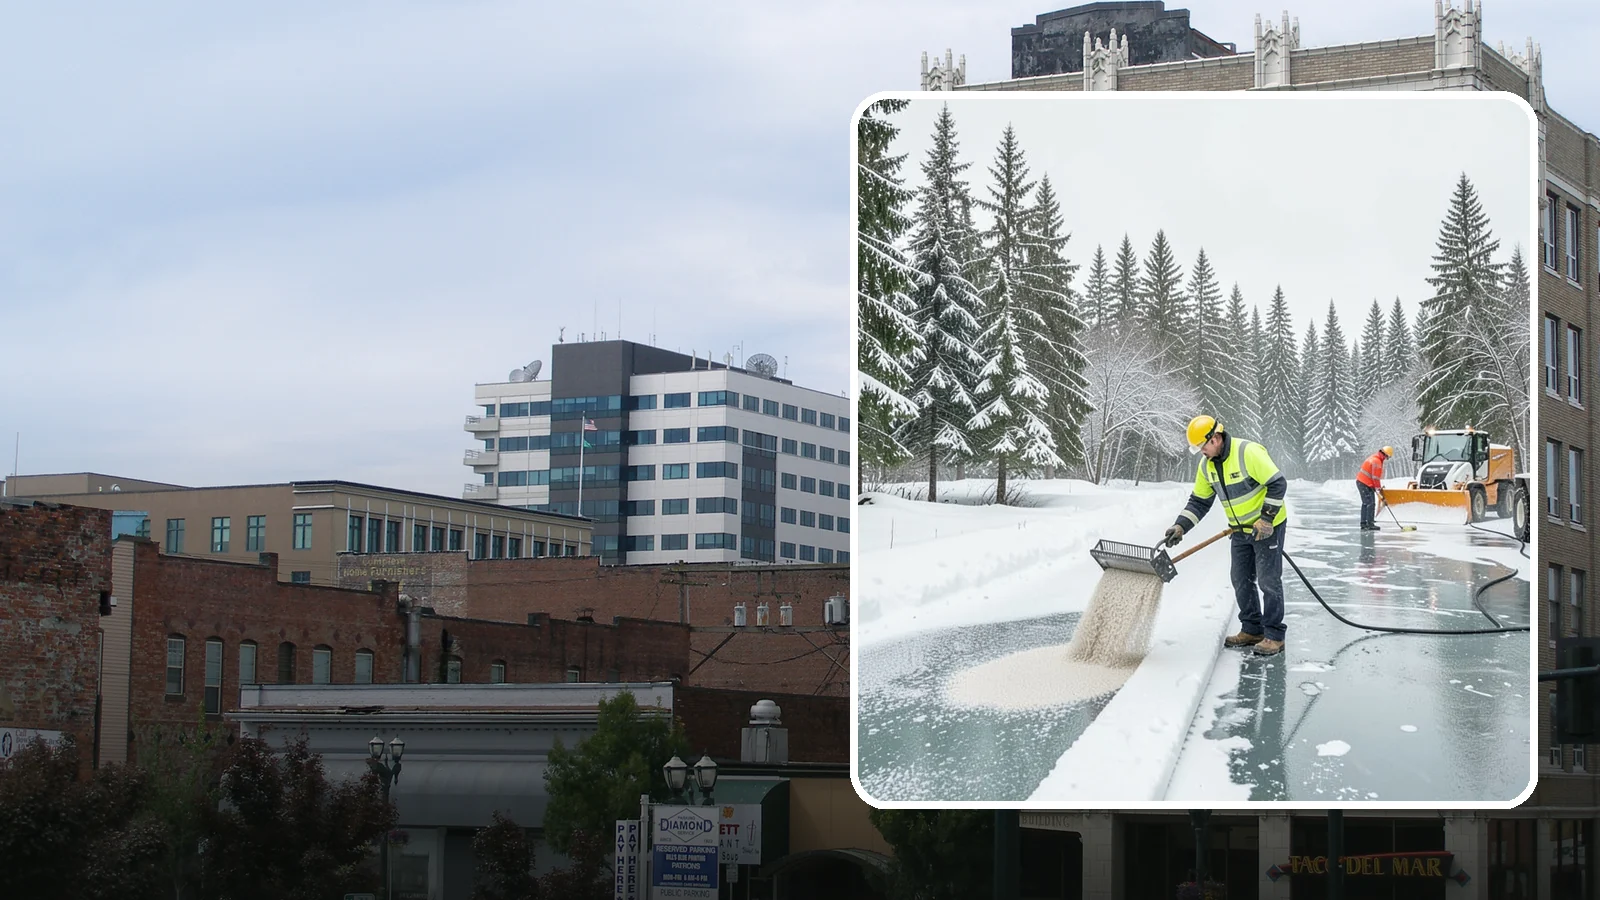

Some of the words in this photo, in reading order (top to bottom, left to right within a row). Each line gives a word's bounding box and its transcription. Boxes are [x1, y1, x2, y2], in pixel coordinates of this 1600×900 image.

[343, 567, 367, 577] Home
[370, 566, 427, 577] Furnishers
[660, 818, 713, 832] DIAMOND
[1022, 815, 1070, 827] BUILDING
[720, 824, 740, 835] ETT
[720, 839, 740, 848] ANT
[656, 845, 688, 853] RESERVED
[689, 846, 716, 854] PARKING
[722, 852, 739, 862] Soup
[1346, 856, 1384, 876] DEL
[1392, 857, 1443, 877] MAR
[628, 856, 636, 893] HERE
